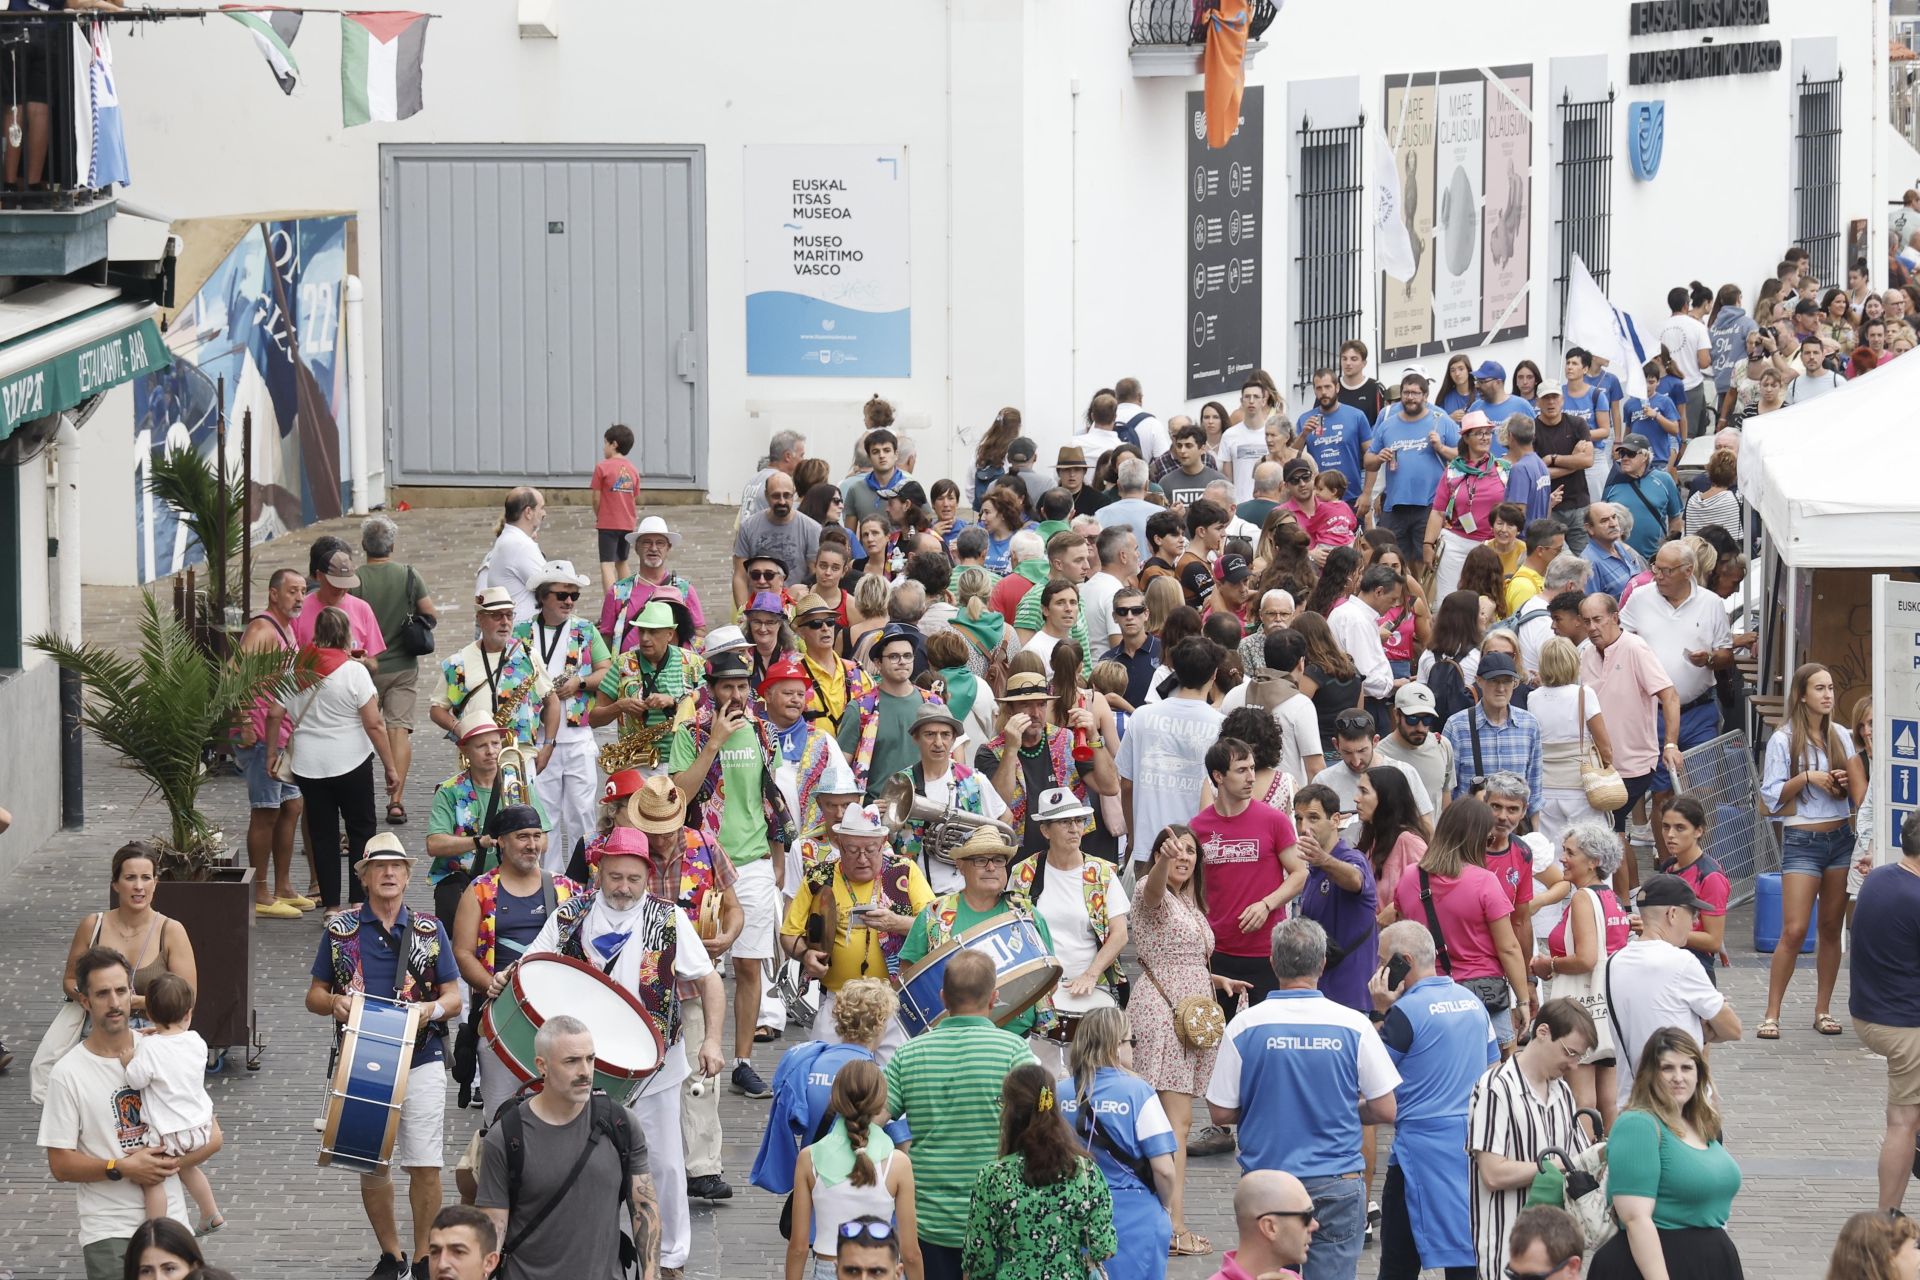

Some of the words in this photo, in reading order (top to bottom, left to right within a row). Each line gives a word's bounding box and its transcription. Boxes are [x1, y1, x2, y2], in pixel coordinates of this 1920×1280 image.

[1639, 1, 1687, 35] EUSKAL
[1688, 0, 1721, 30] ITSAS
[1723, 0, 1770, 28] MUSEOA
[1638, 50, 1681, 84] MUSEO
[1745, 40, 1782, 74] VASCO
[1449, 93, 1473, 117] MARE
[1440, 118, 1481, 144] CLAUSUM
[792, 179, 848, 191] EUSKAL
[793, 193, 832, 205] ITSAS
[793, 207, 852, 219] MUSEOA
[793, 235, 843, 247] MUSEO
[793, 247, 864, 262] MARÍTIMO
[793, 264, 841, 276] VASCO
[128, 329, 149, 372] BAR
[1428, 1000, 1480, 1016] ASTILLERO
[1266, 1037, 1343, 1051] ASTILLERO
